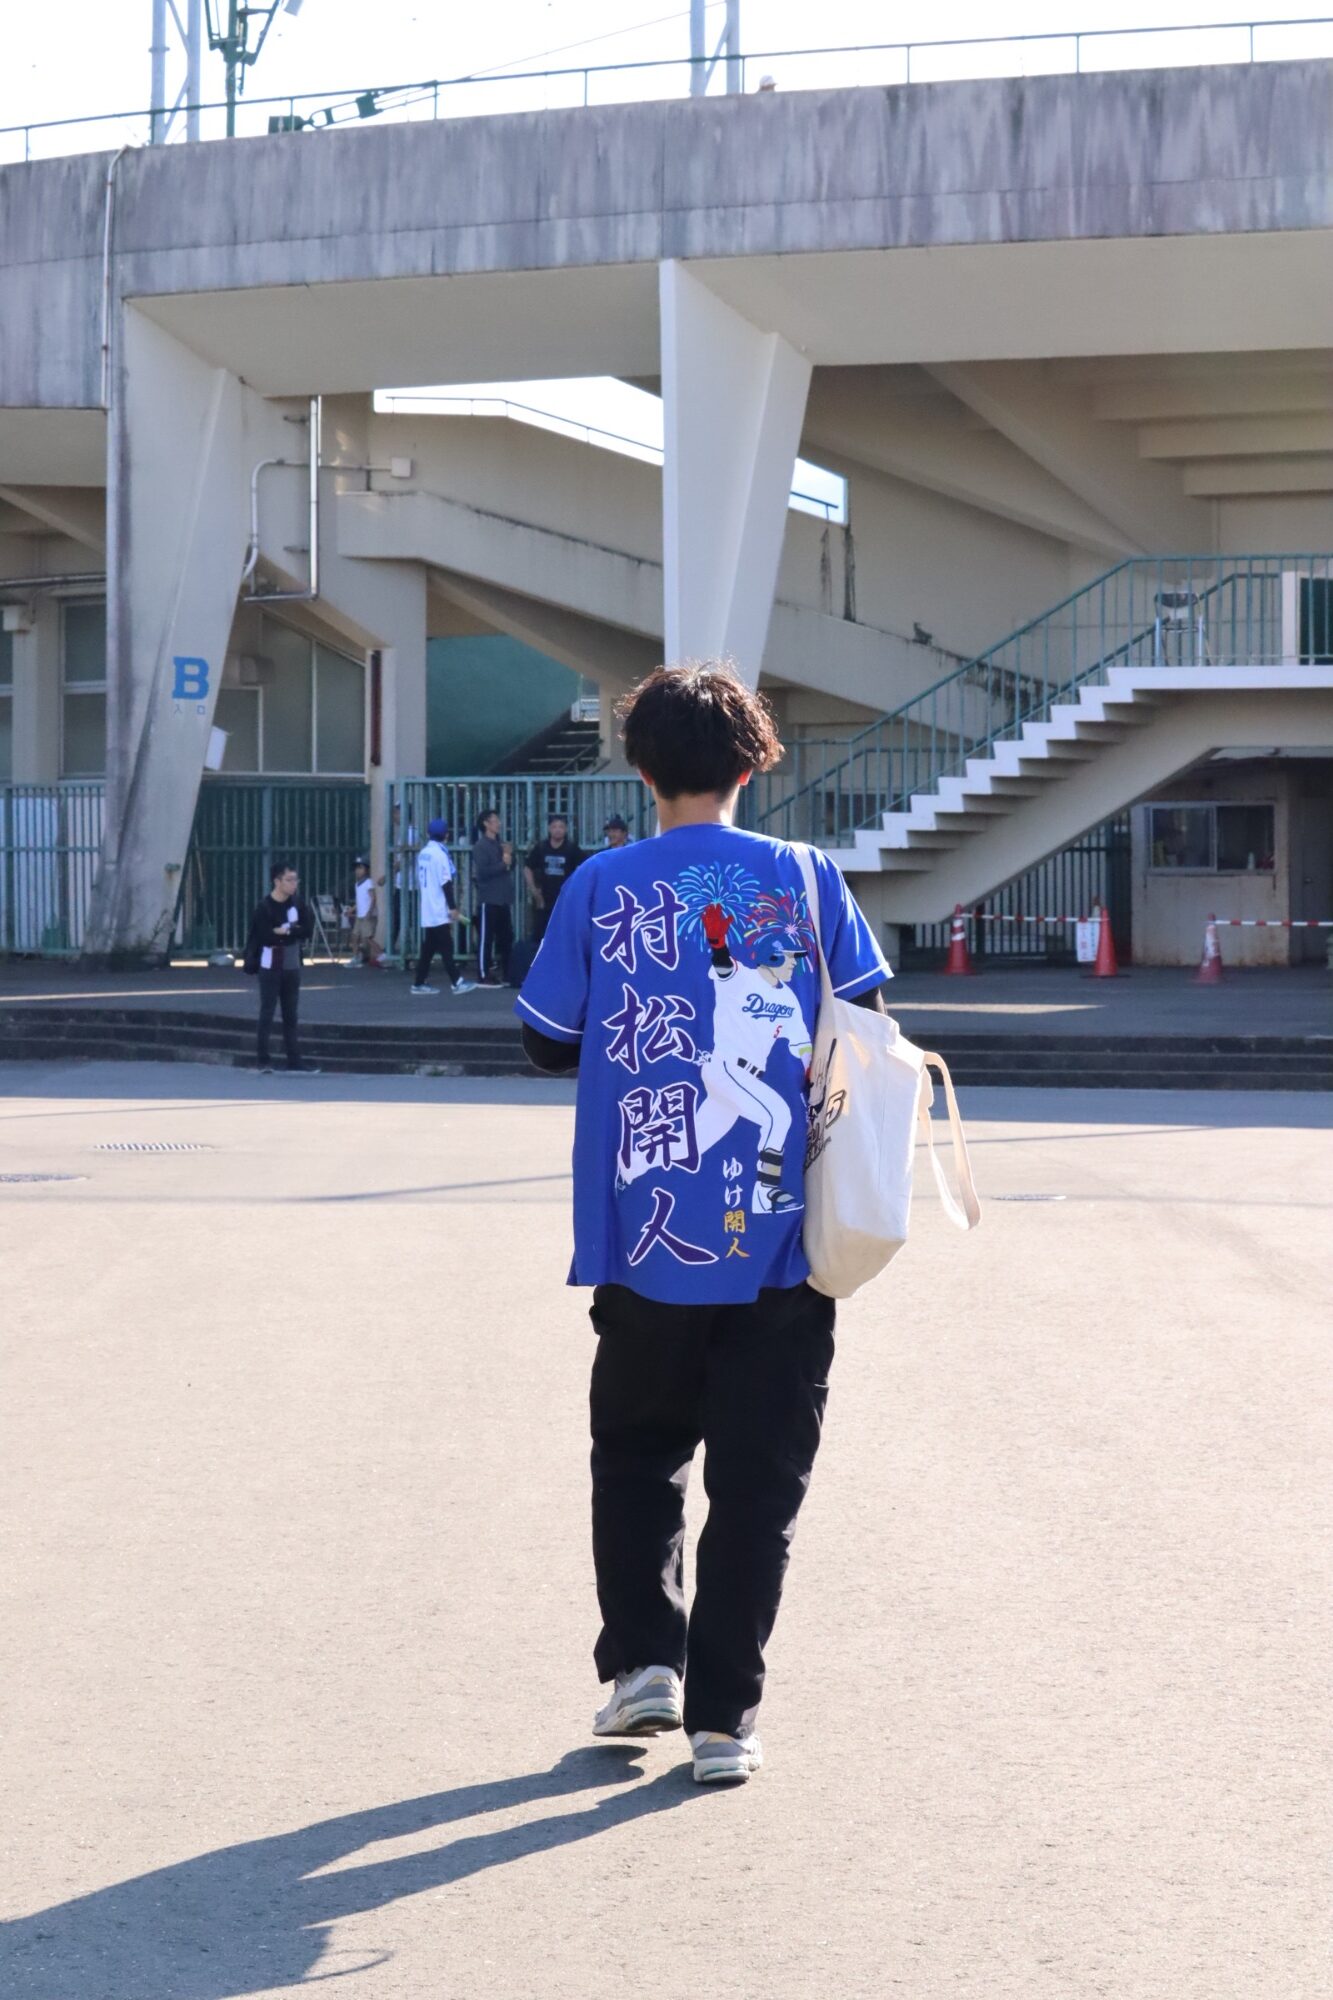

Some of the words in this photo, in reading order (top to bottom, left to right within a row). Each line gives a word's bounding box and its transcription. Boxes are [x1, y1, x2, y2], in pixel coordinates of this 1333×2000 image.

[172, 656, 209, 700] B
[742, 993, 795, 1022] Dragons
[593, 881, 719, 1266] 村松開人
[723, 1156, 749, 1258] ゆけ開人
